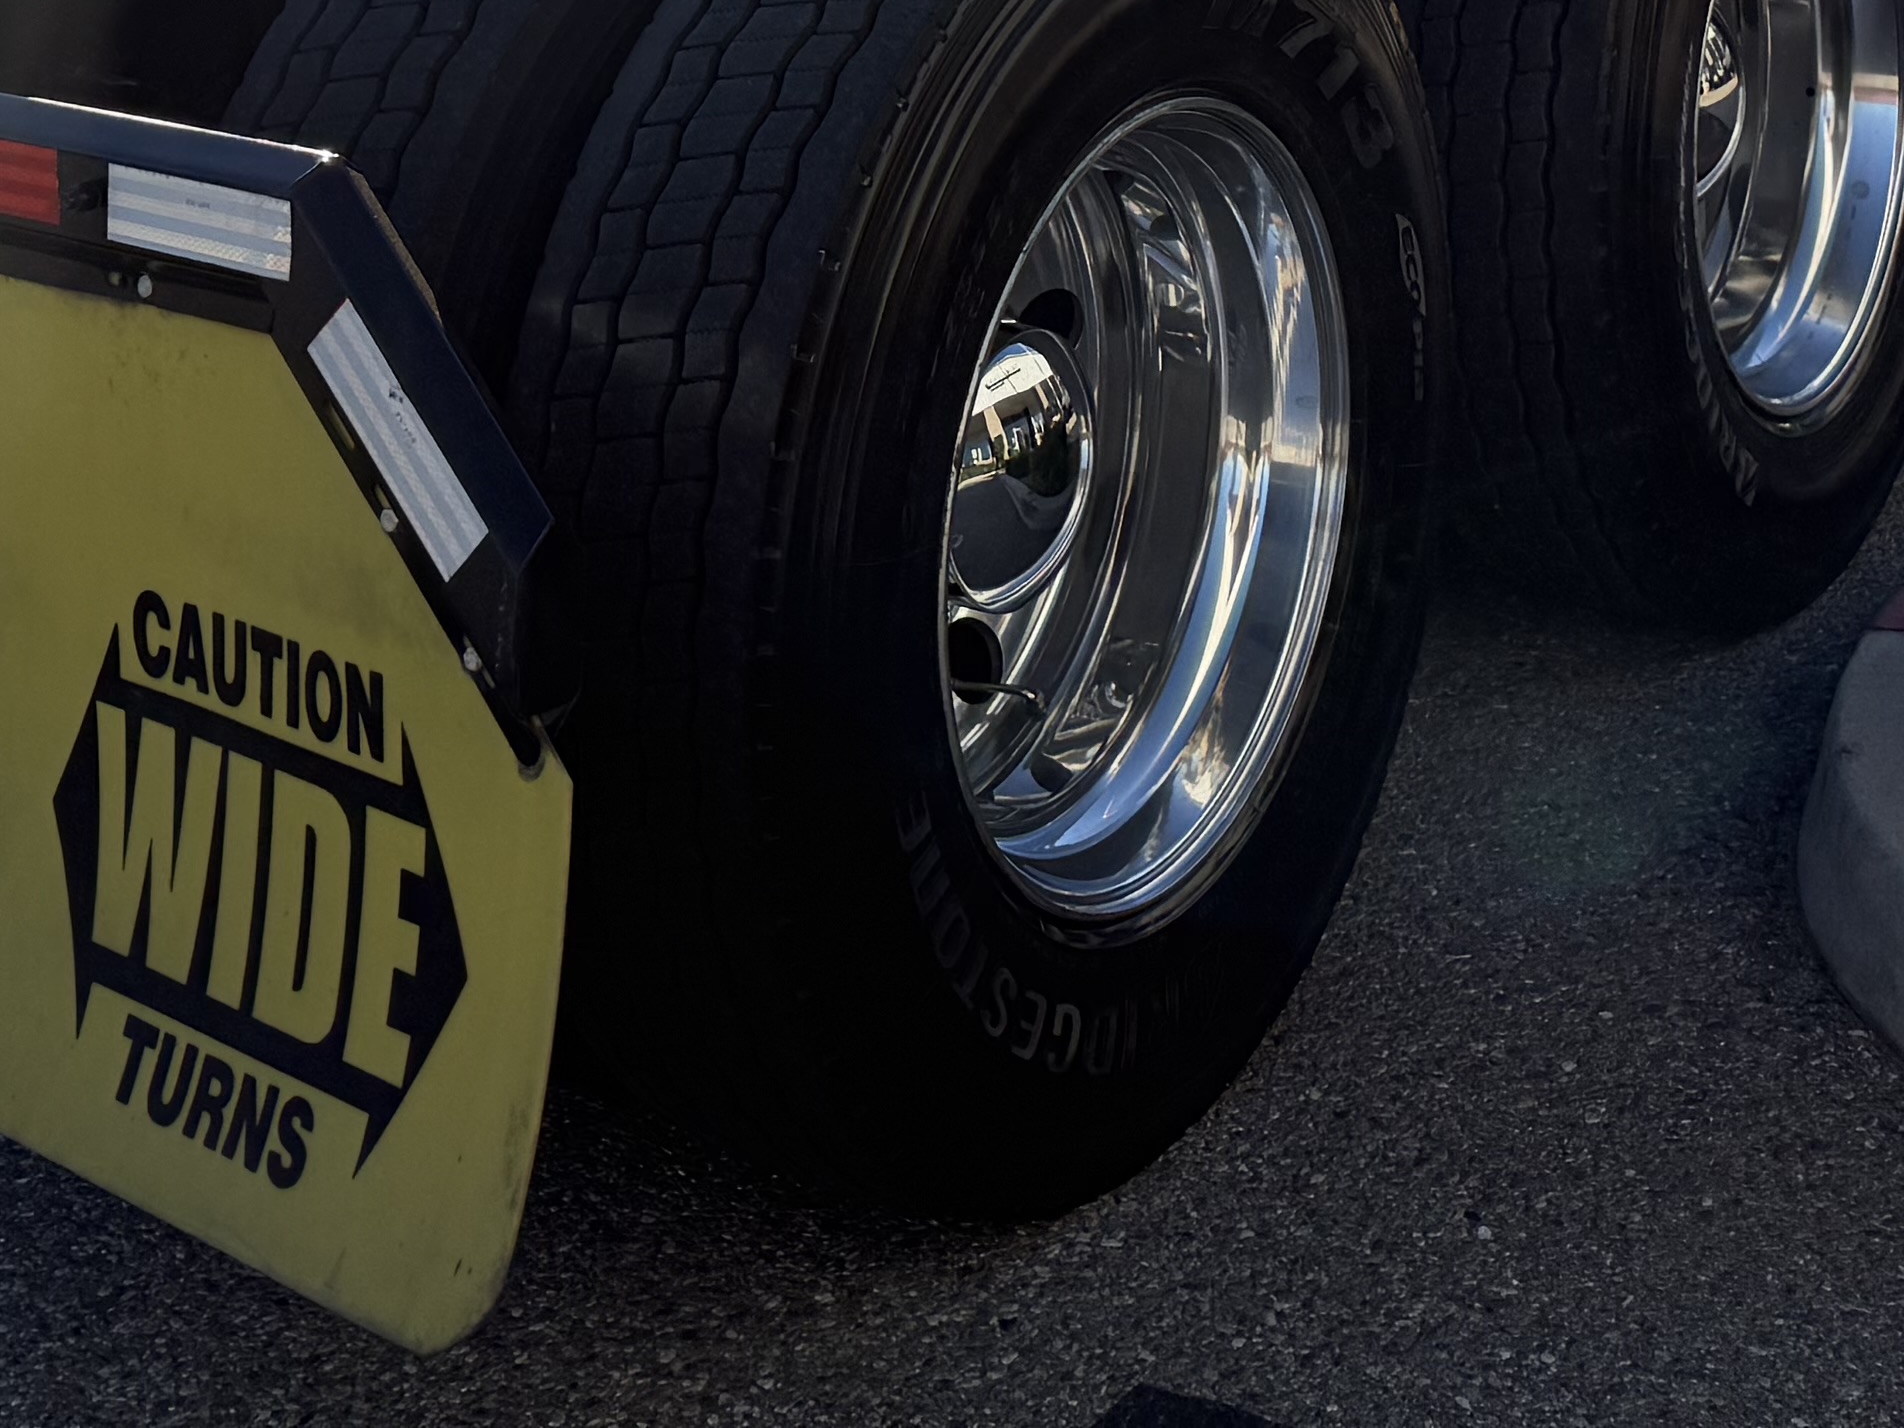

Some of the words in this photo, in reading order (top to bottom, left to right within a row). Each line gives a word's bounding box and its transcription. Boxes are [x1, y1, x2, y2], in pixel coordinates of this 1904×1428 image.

[132, 589, 384, 764] CAUTION
[91, 699, 427, 1089] WIDE
[896, 789, 1181, 1078] IDGESTONE
[114, 1013, 314, 1190] TURNS
